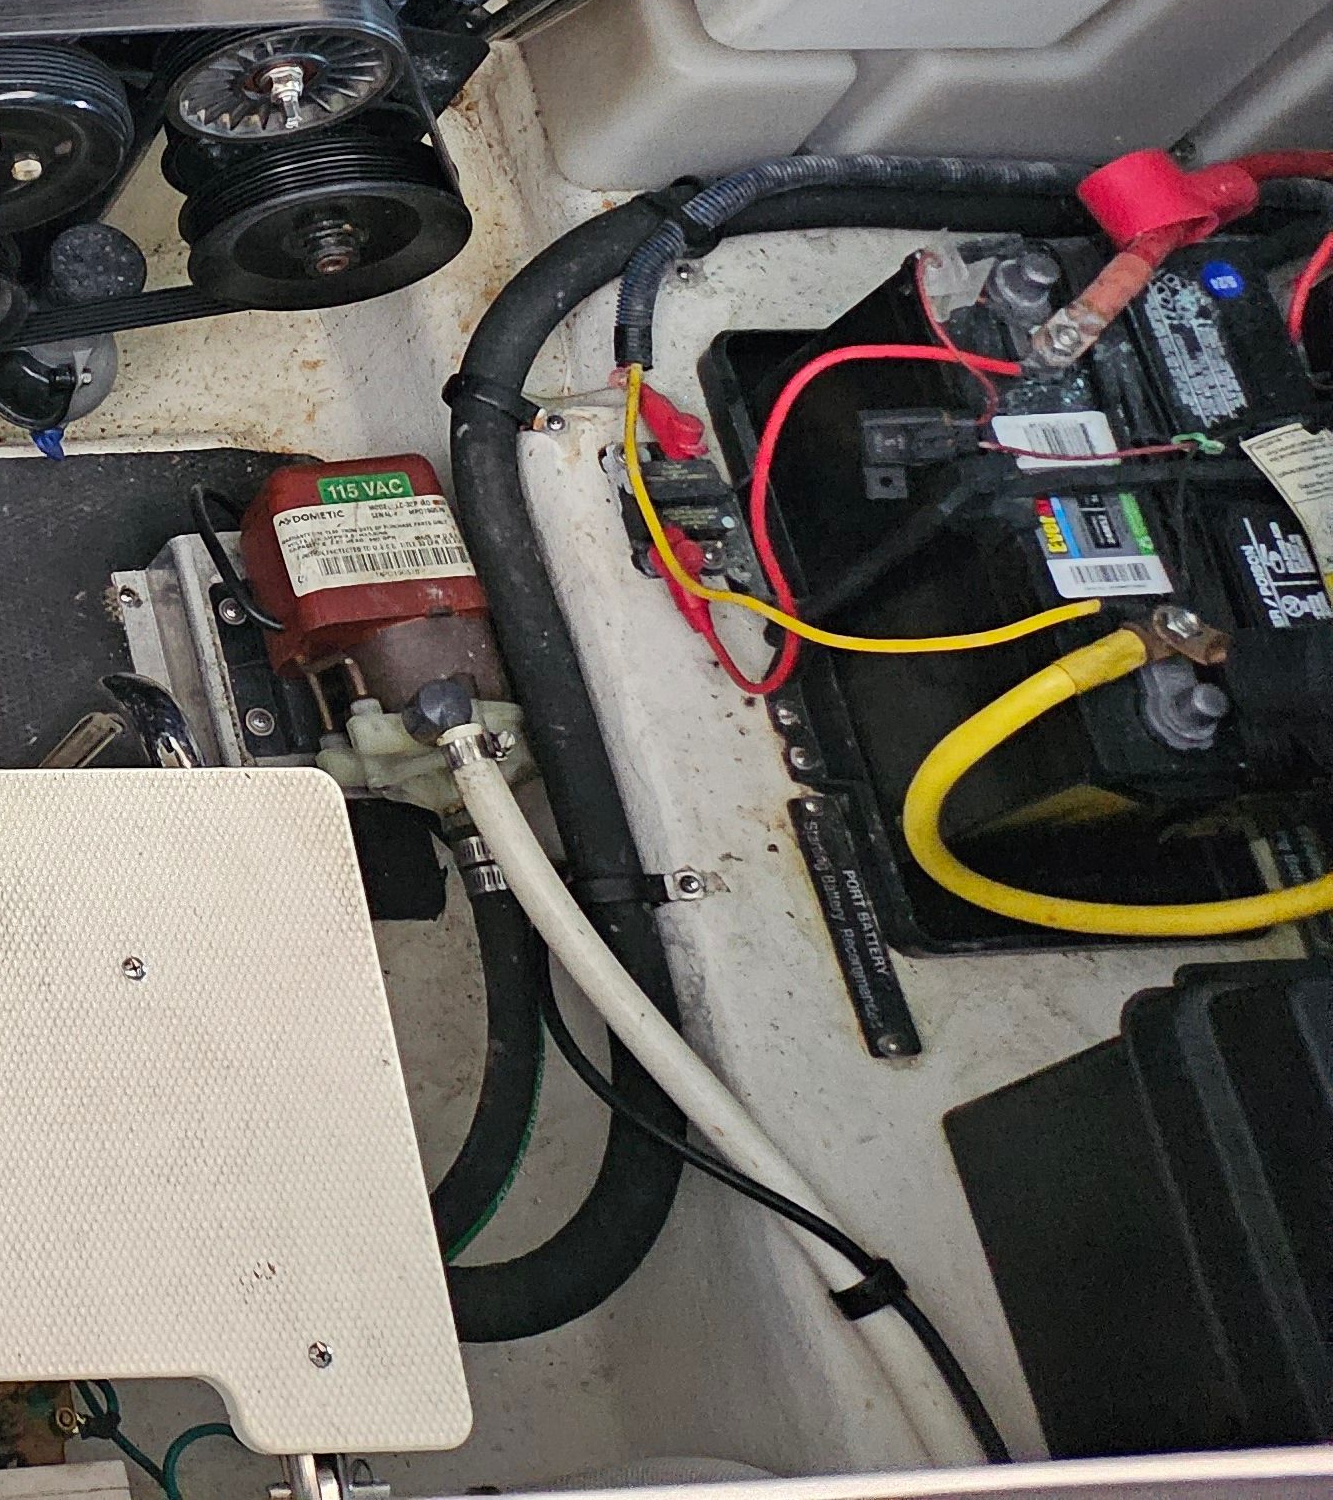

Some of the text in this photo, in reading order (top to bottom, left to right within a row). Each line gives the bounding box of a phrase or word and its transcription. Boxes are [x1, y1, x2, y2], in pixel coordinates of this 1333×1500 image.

[326, 478, 404, 500] 115 VAC
[291, 509, 345, 524] DOMETIC
[821, 873, 846, 925] Battery
[842, 868, 890, 976] PORT BATTERY
